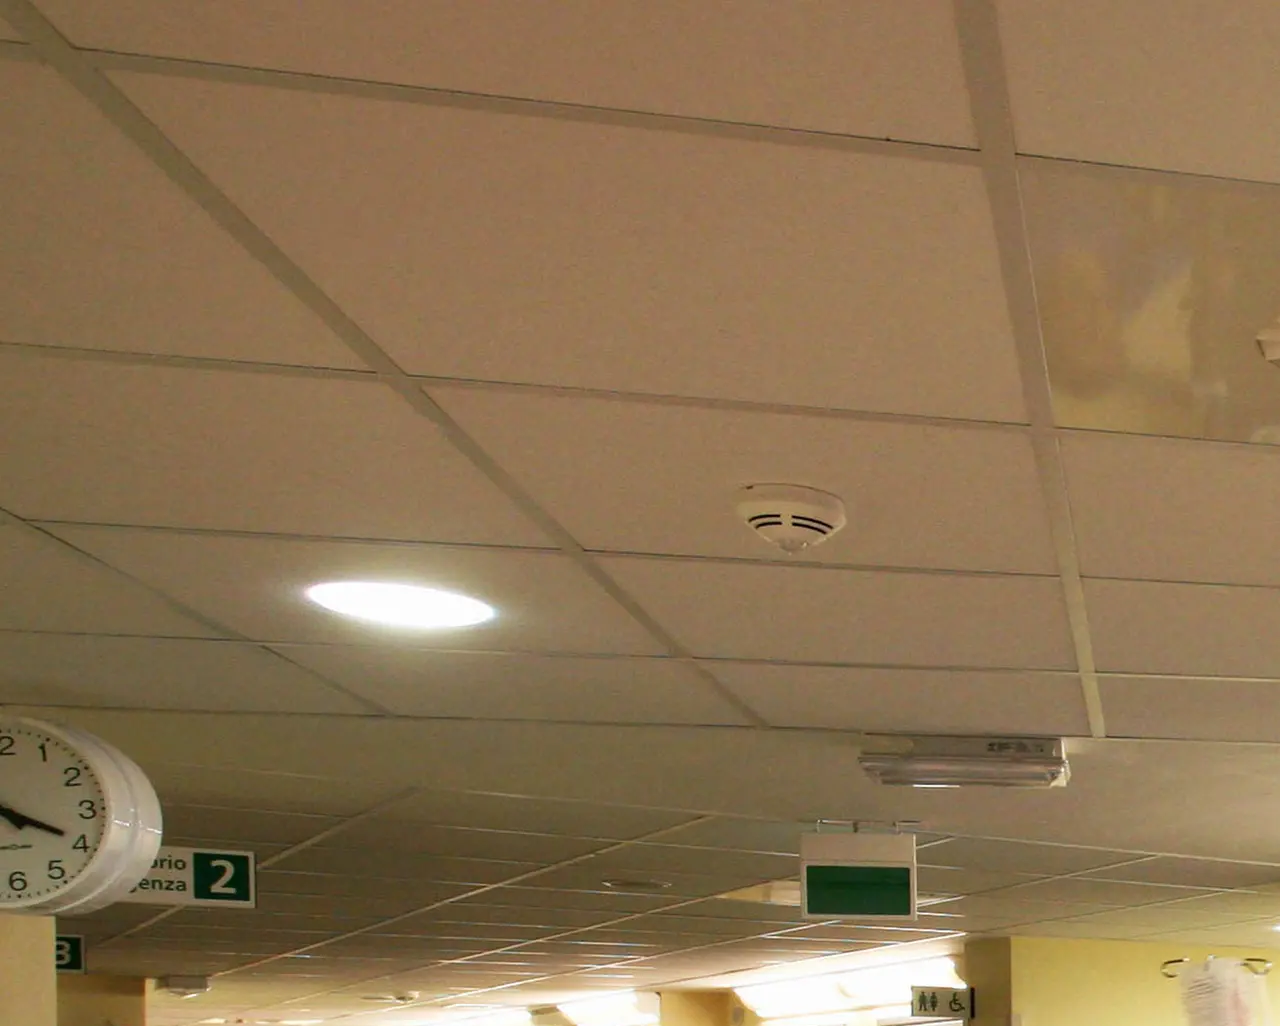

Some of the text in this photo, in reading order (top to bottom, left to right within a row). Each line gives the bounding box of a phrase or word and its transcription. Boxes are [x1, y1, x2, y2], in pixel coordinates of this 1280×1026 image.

[38, 743, 47, 762] 1
[63, 767, 82, 787] 2
[78, 800, 97, 820] 3
[72, 834, 91, 853] 4
[48, 860, 66, 880] 5
[210, 859, 237, 894] 2
[9, 871, 28, 891] 6
[129, 877, 187, 894] enza
